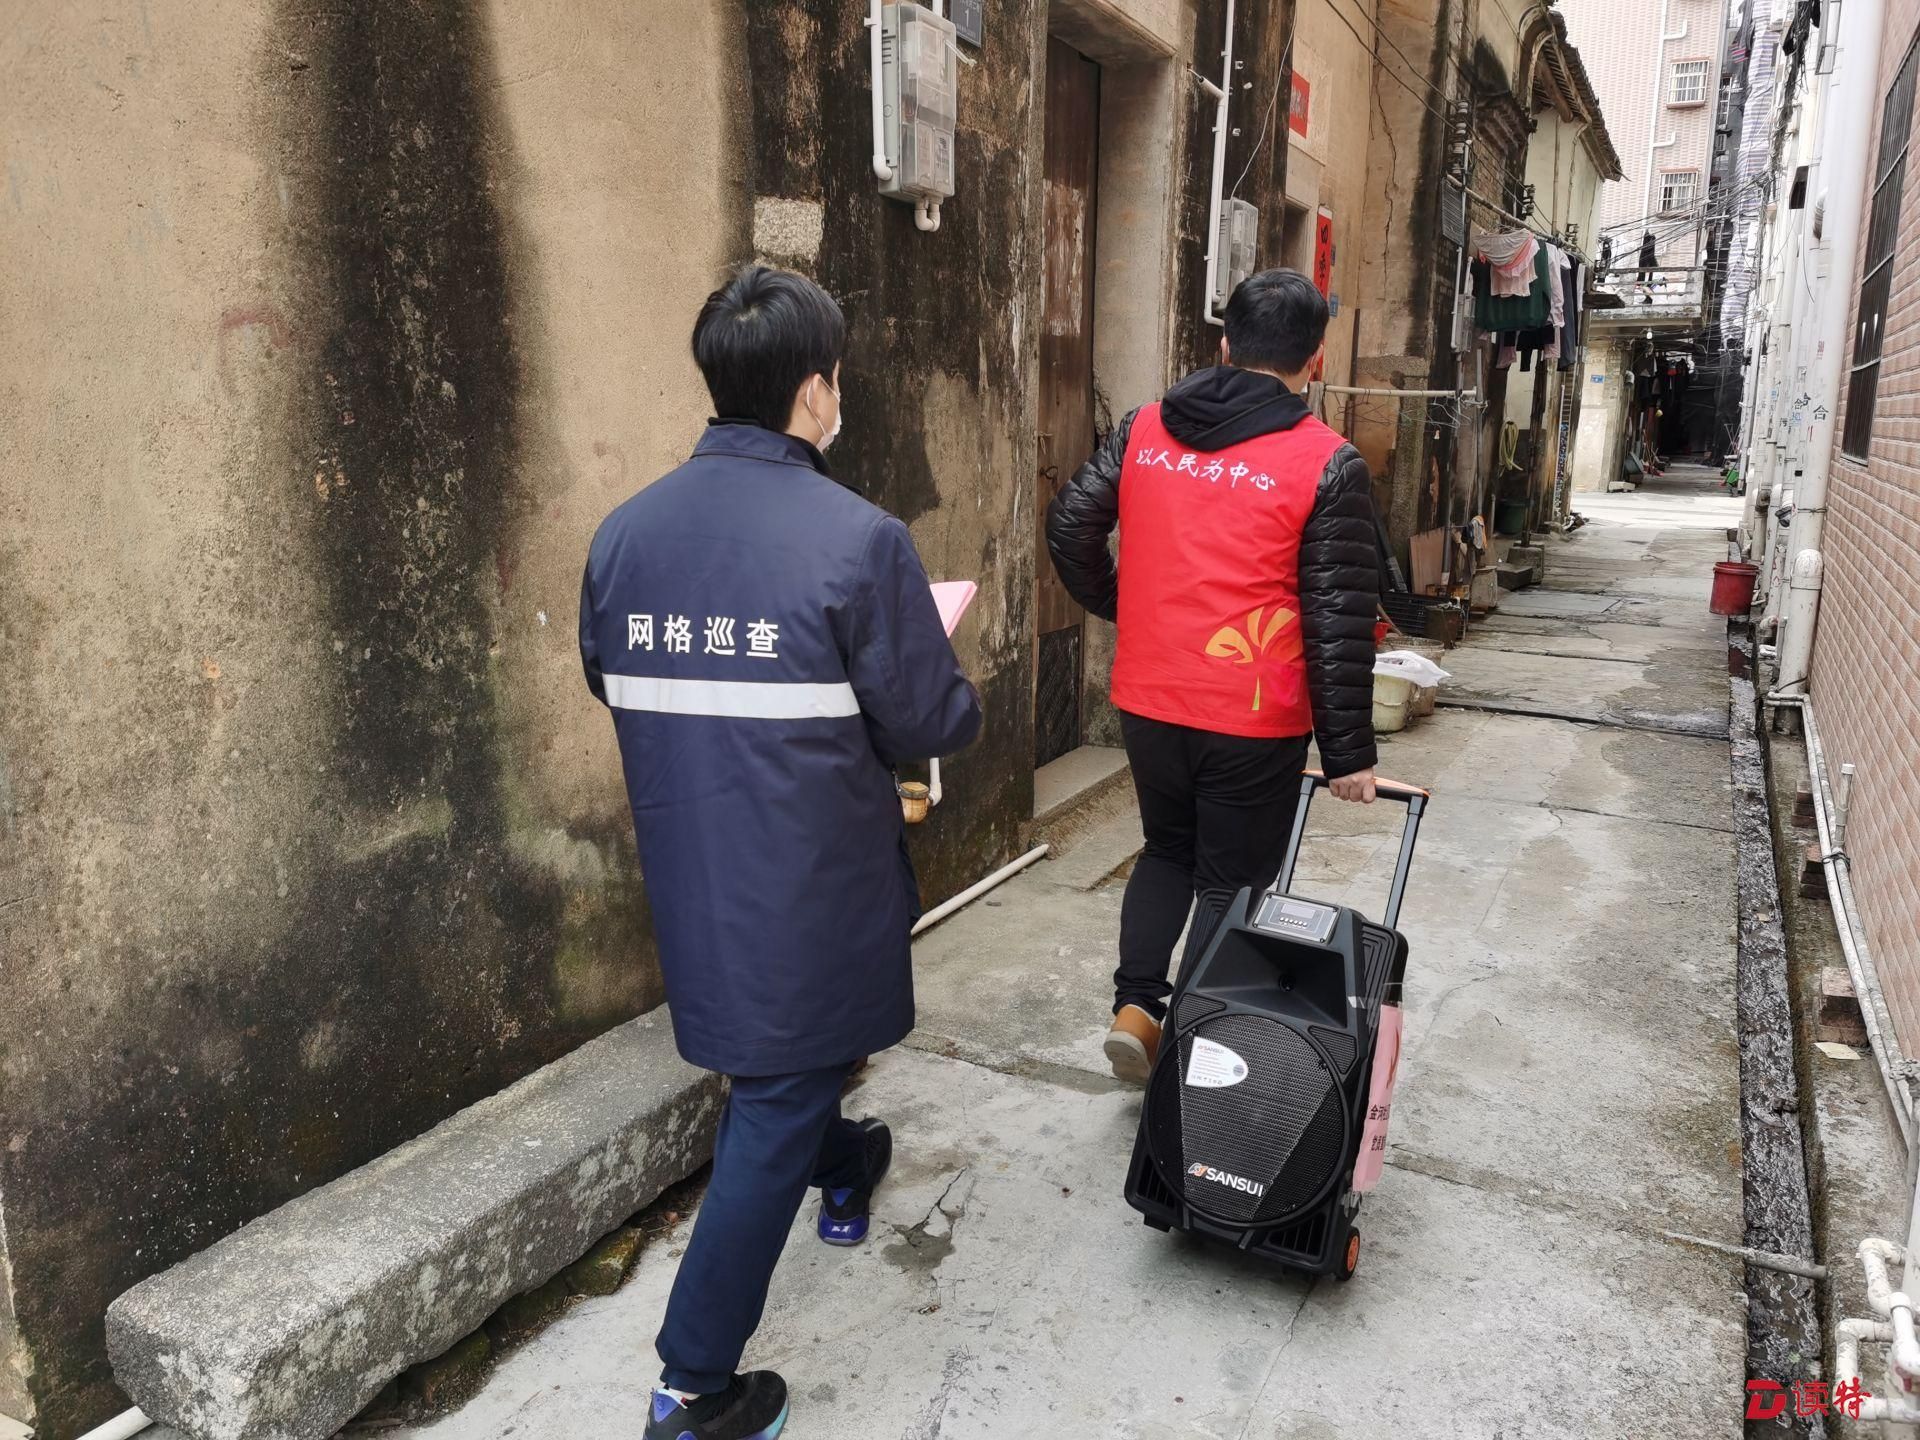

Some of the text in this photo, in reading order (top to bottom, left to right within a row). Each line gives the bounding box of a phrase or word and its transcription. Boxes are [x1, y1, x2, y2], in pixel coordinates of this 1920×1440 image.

[1136, 448, 1276, 490] 以人民为中心
[627, 613, 780, 659] 网格巡查
[1205, 1167, 1264, 1198] SANSUI
